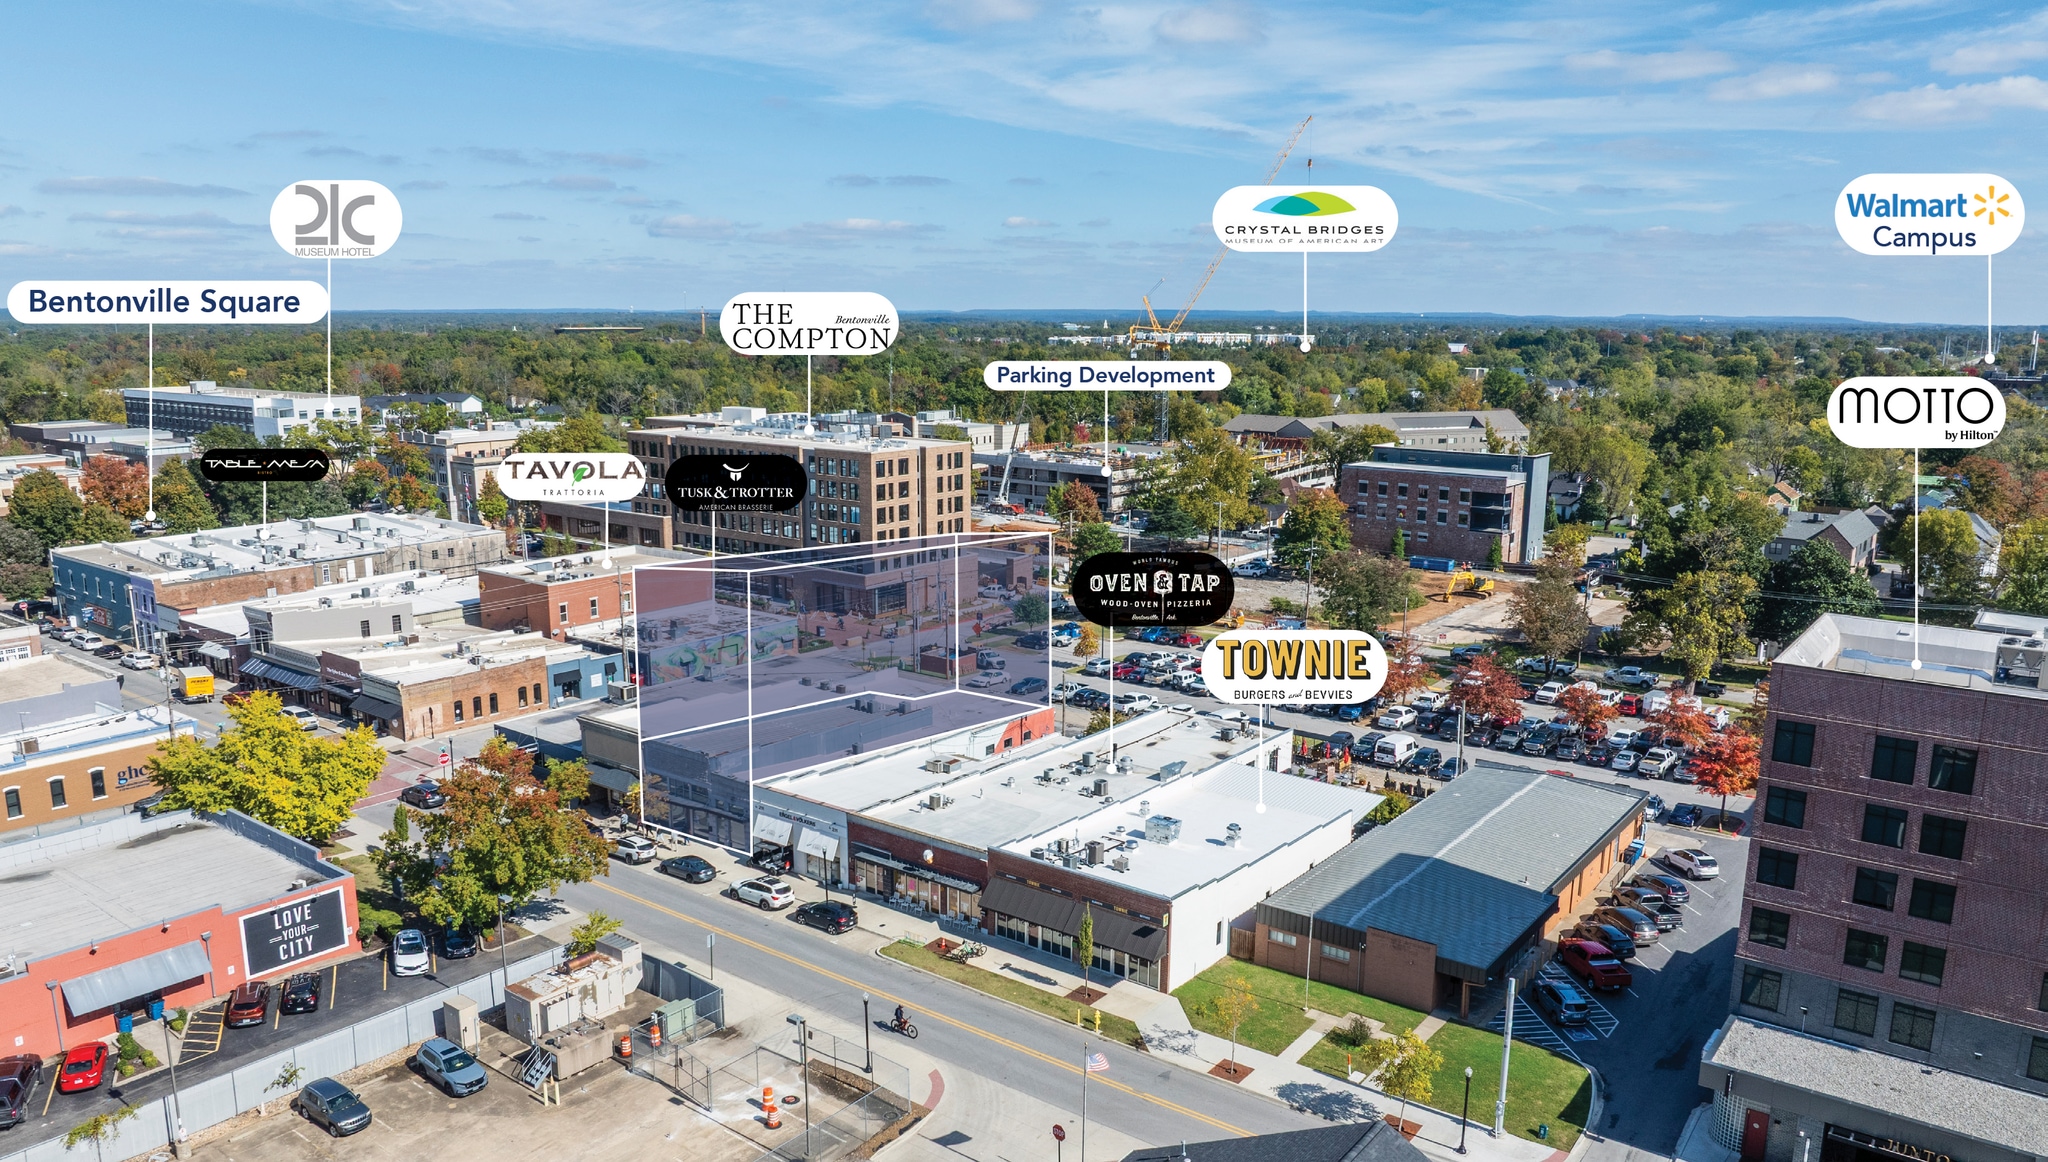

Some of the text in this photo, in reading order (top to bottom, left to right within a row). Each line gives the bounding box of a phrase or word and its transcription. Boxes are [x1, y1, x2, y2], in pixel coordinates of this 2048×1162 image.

[273, 903, 312, 930] LOVE
[282, 924, 307, 941] YOUR
[279, 935, 314, 961] CITY
